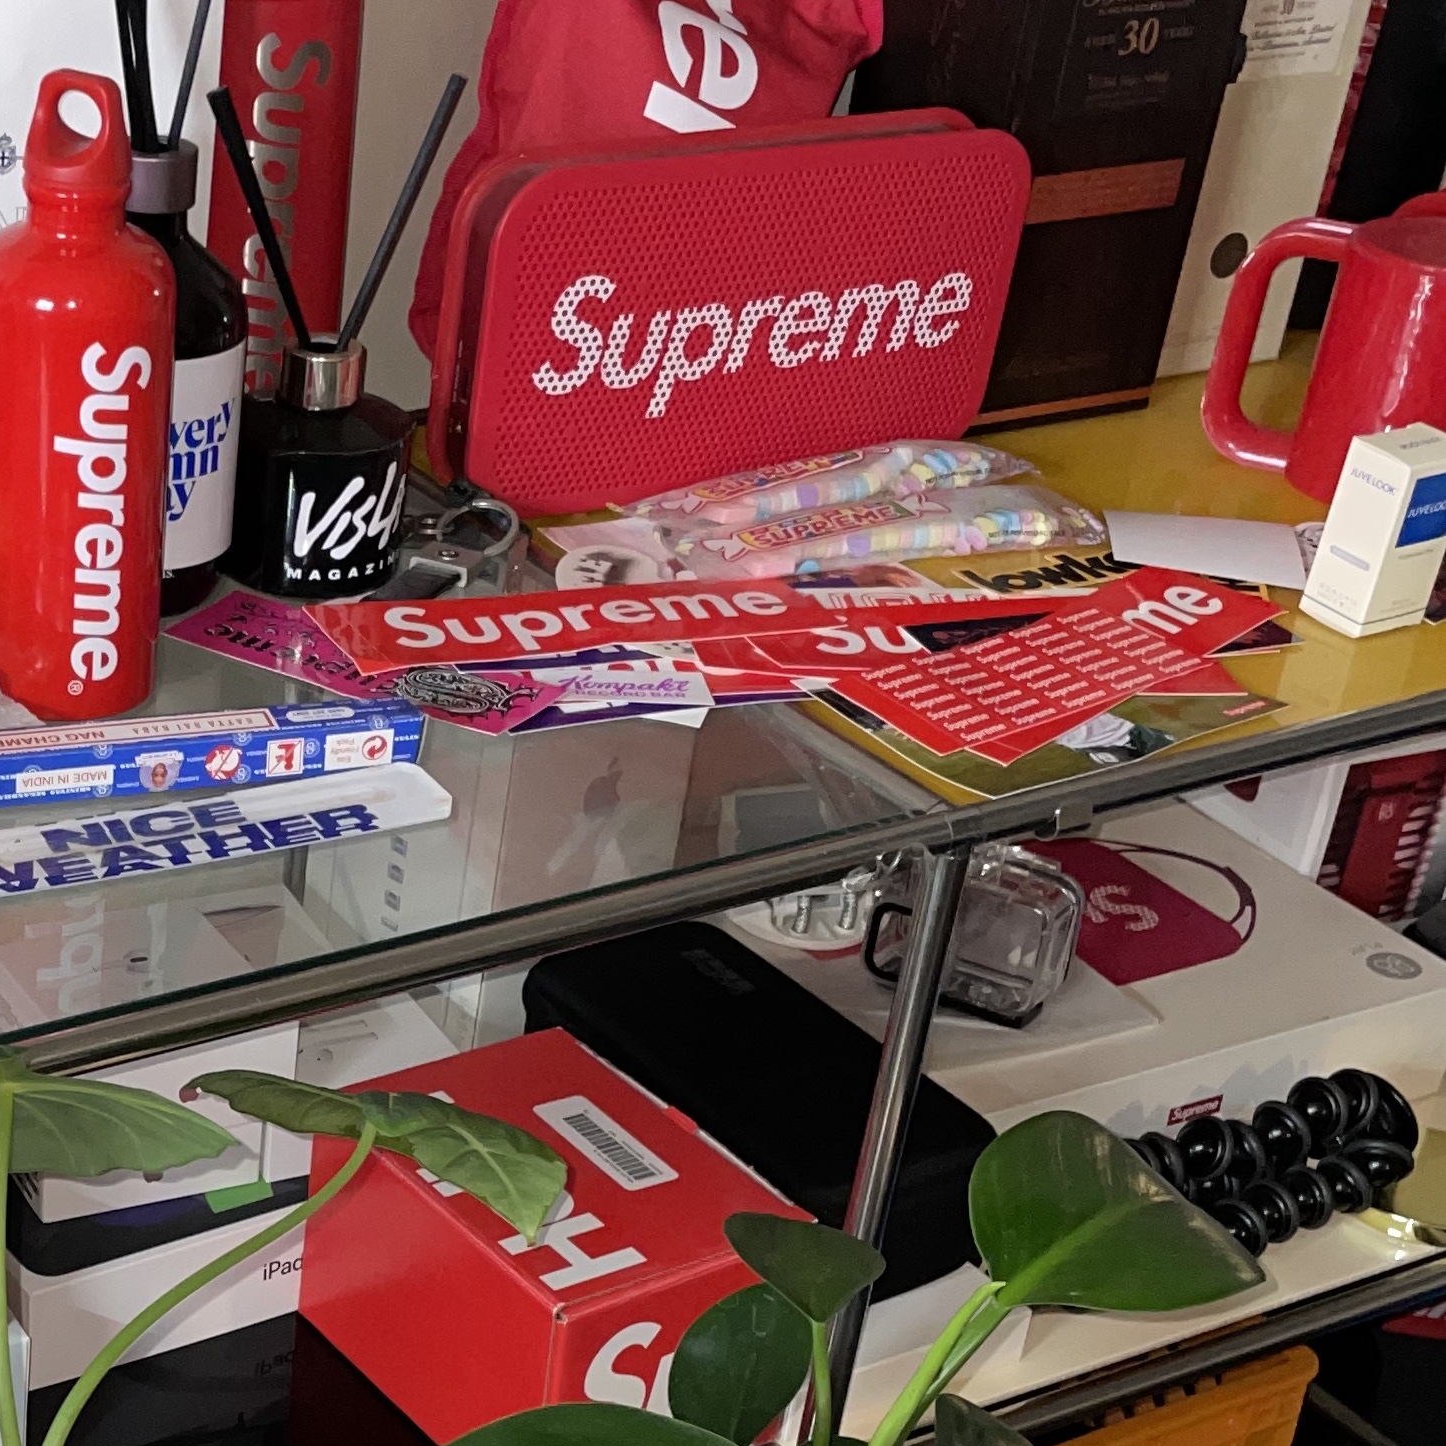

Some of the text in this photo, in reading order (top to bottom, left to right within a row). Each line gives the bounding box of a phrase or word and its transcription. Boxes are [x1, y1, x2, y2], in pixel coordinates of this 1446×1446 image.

[1118, 17, 1160, 56] 30
[242, 32, 333, 398] Supreme
[532, 272, 974, 419] Supreme
[169, 397, 236, 449] very
[170, 445, 219, 481] mn
[1350, 468, 1396, 496] JUVELOOK
[753, 504, 900, 548] SUPREME
[286, 552, 401, 581] MAGAZIN
[383, 583, 788, 652] Supreme
[559, 674, 690, 694] Kompakt
[944, 714, 989, 731] Supreme
[1011, 708, 1056, 725] Supreme
[71, 728, 106, 742] NAG
[960, 723, 1006, 742] Supreme
[20, 767, 109, 790] MADE IN INDIA
[41, 799, 248, 853] NICE
[1171, 1098, 1221, 1122] Supreme
